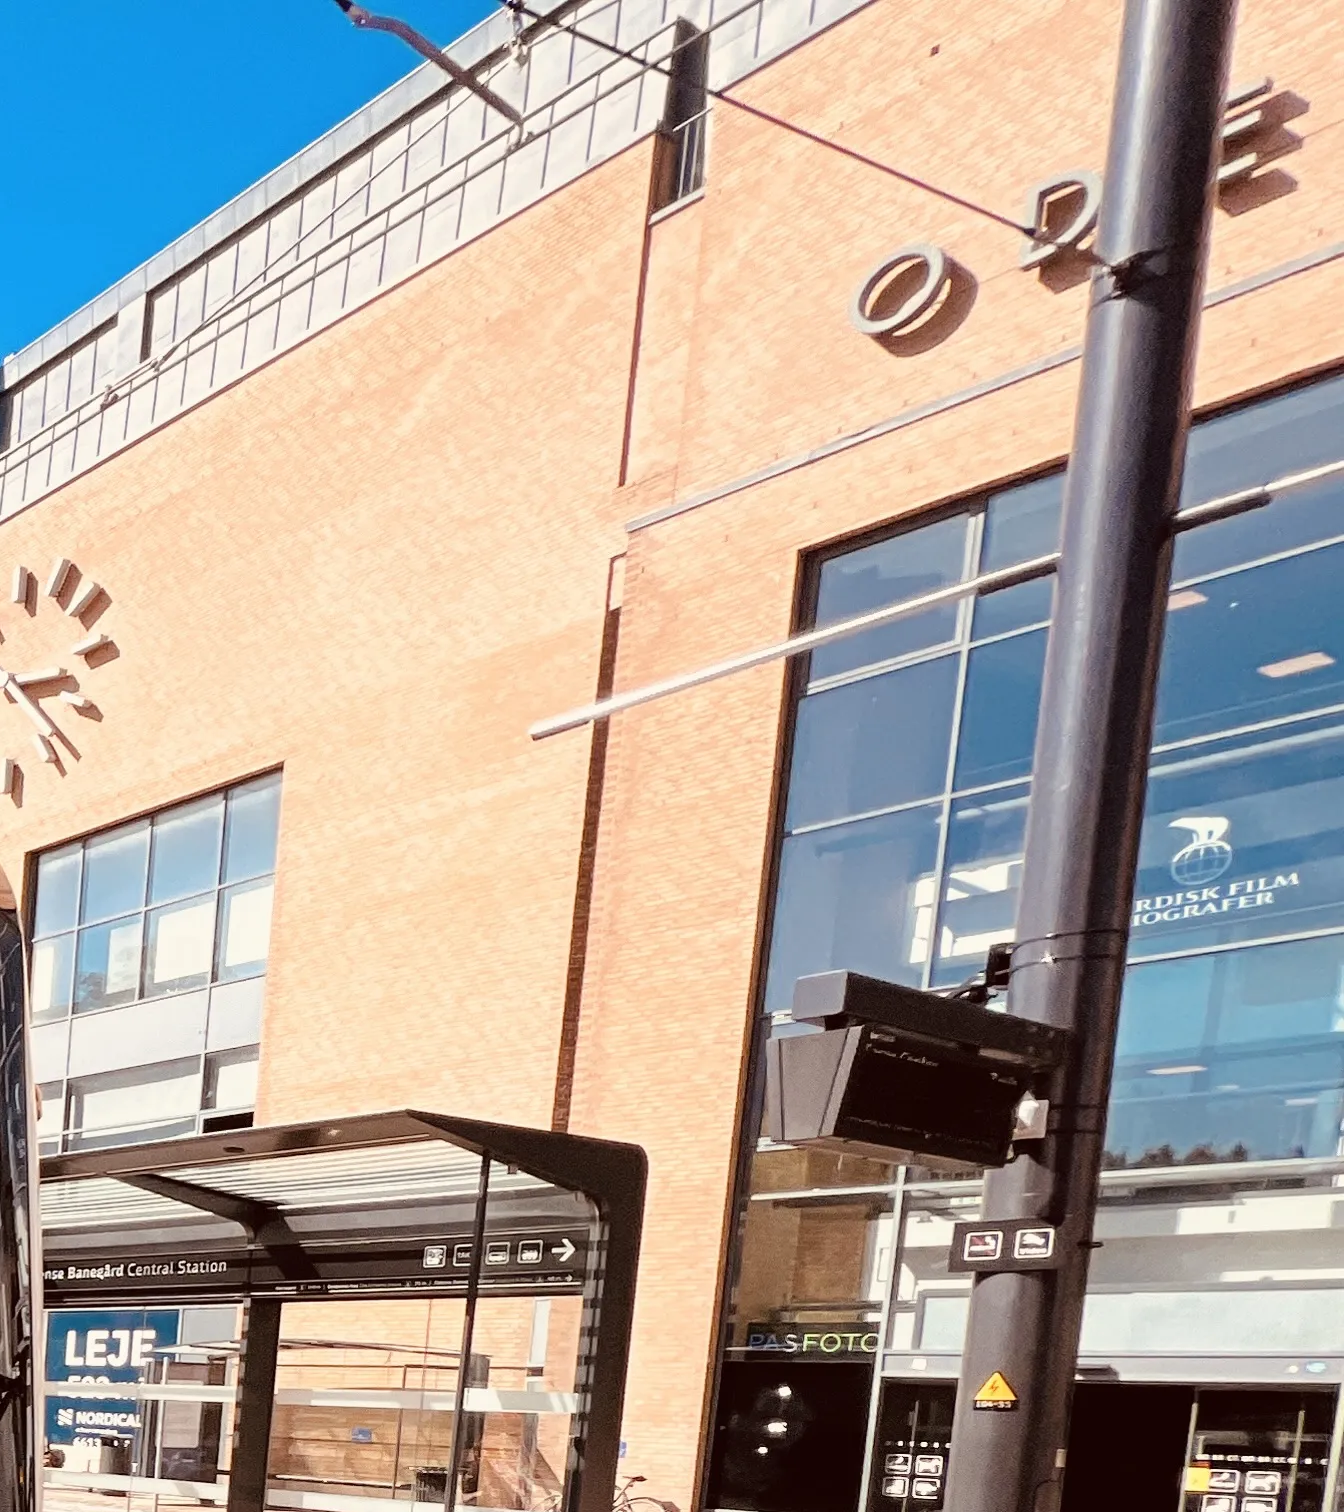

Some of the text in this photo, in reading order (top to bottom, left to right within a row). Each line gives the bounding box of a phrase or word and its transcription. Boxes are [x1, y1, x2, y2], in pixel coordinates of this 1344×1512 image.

[1228, 872, 1300, 897] FILM
[41, 1259, 228, 1281] nse Banegård Central Station
[64, 1330, 157, 1367] LEJE
